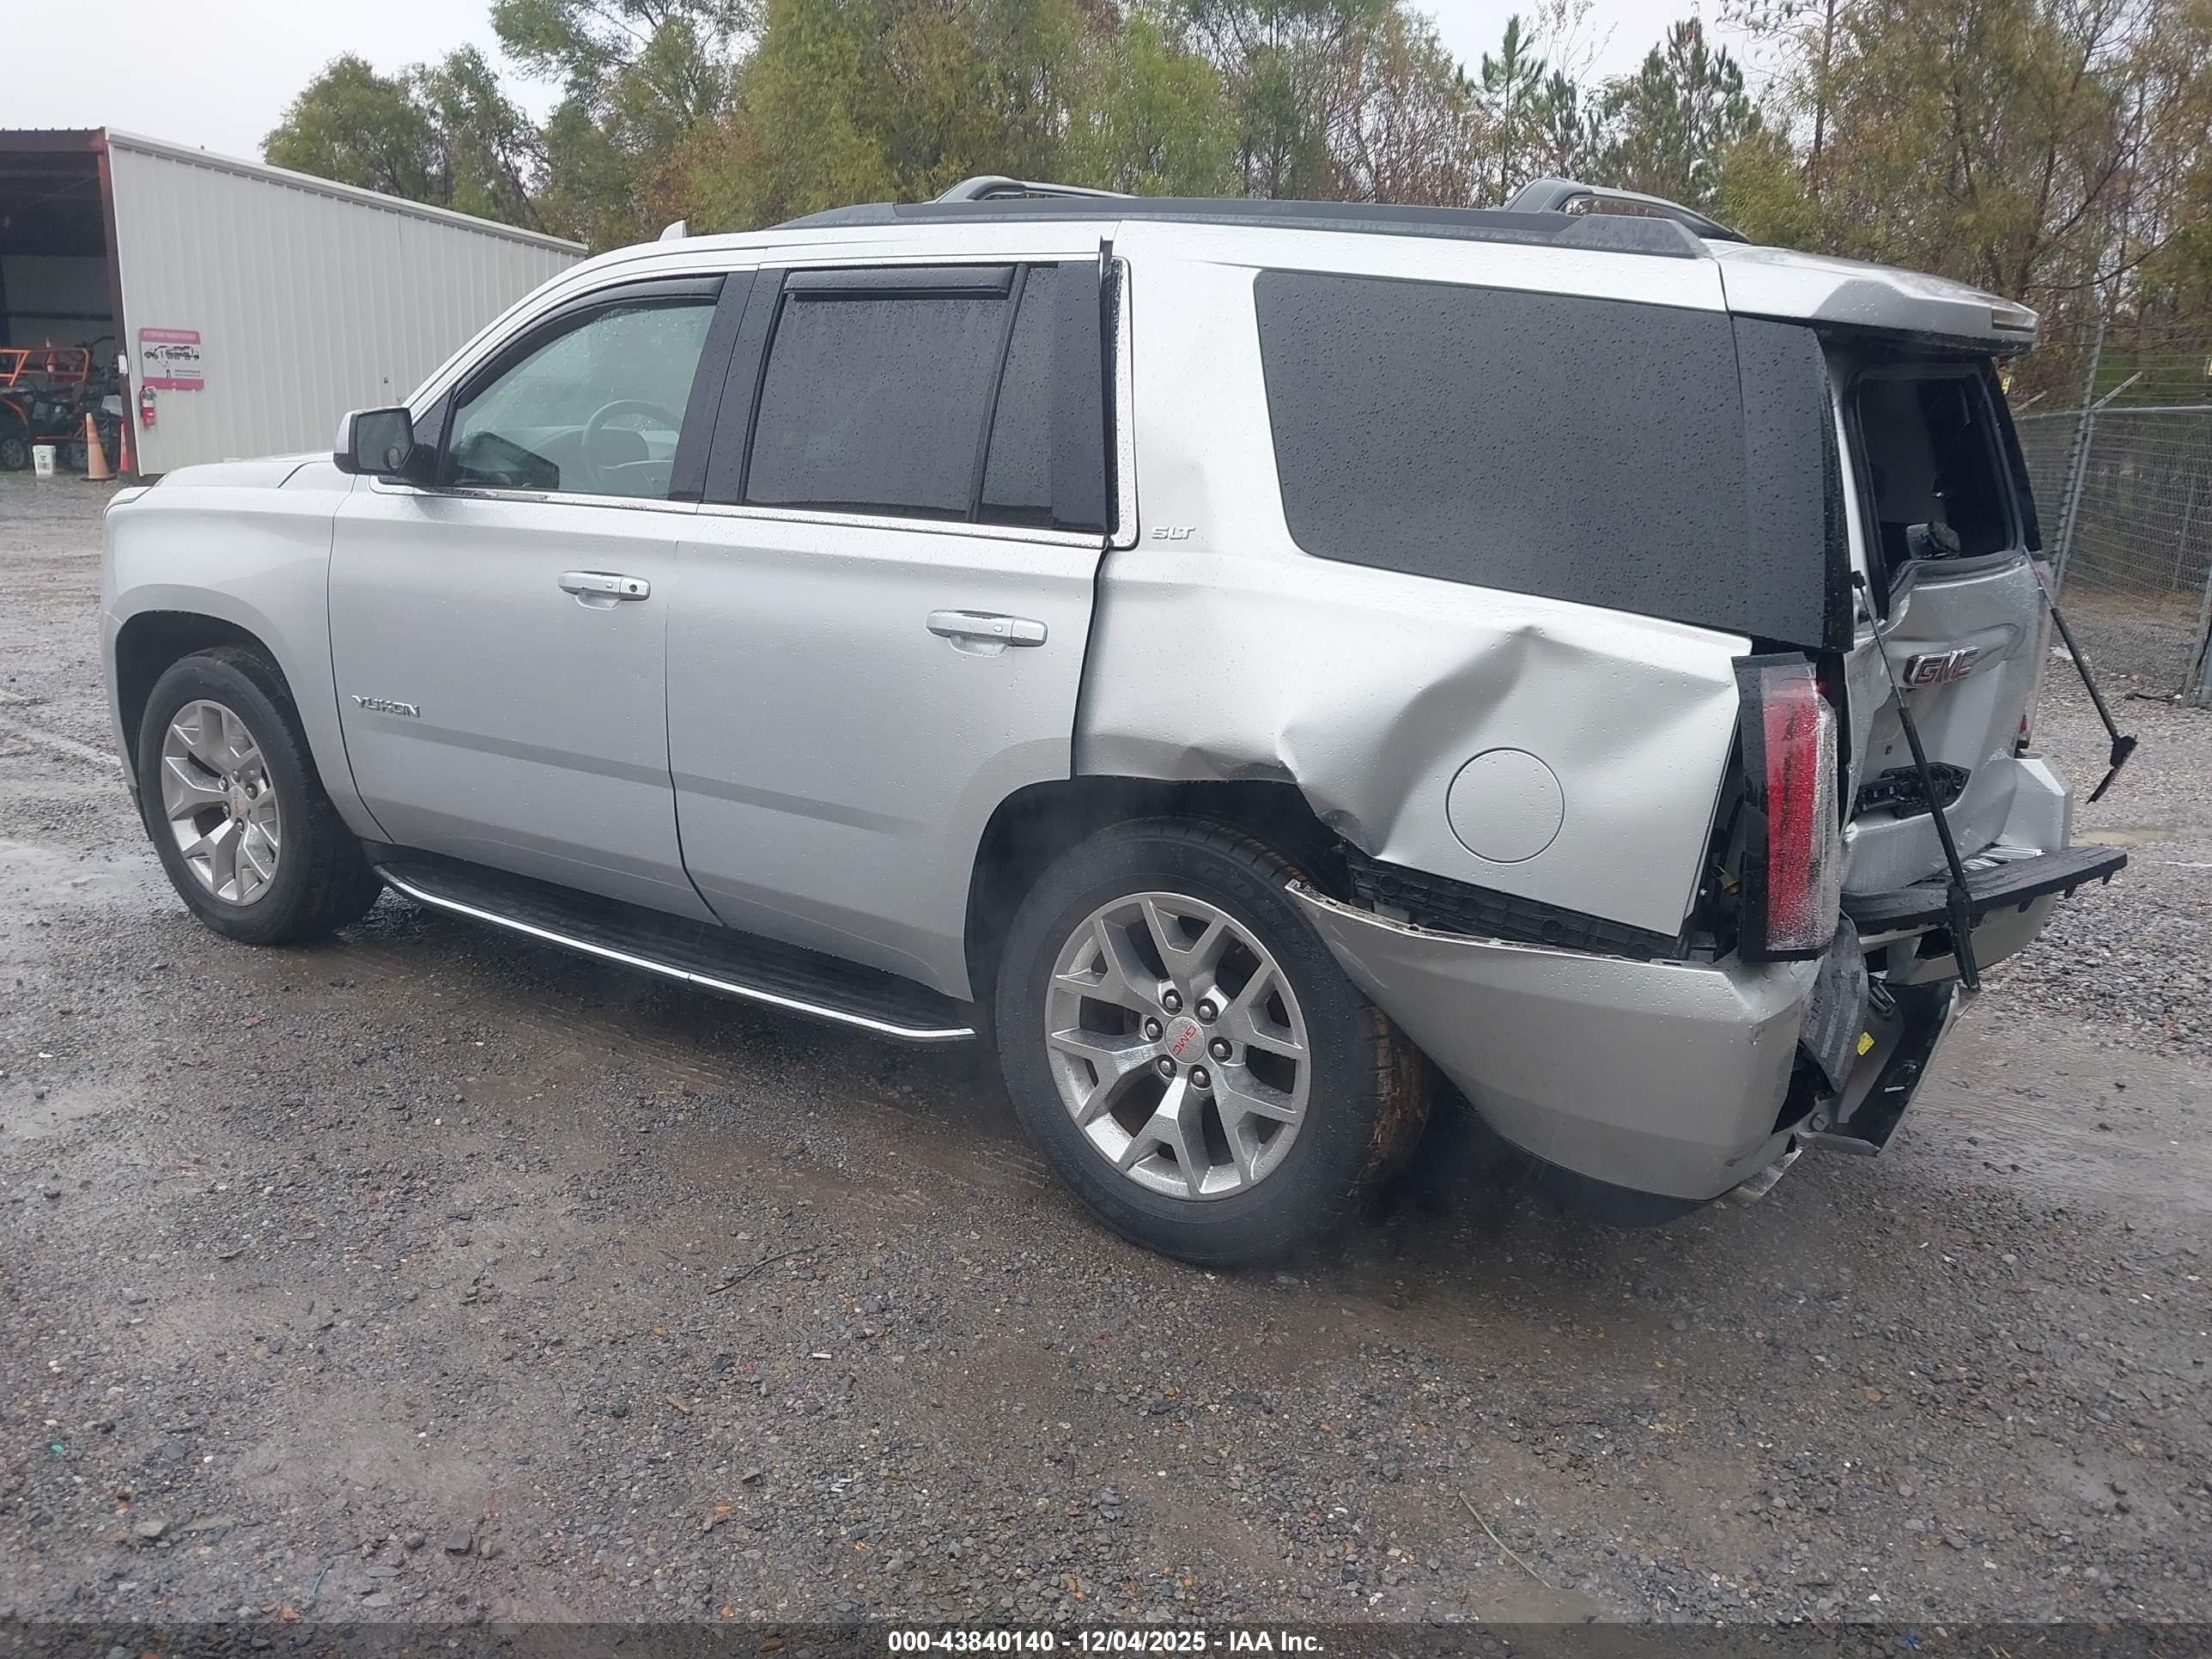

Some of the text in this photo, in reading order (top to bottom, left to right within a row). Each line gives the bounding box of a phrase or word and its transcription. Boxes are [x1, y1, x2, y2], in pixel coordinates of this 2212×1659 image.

[1151, 526, 1195, 540] SLT
[1911, 646, 1979, 684] GMC
[350, 695, 420, 718] YUKON
[1172, 1024, 1197, 1055] GMC
